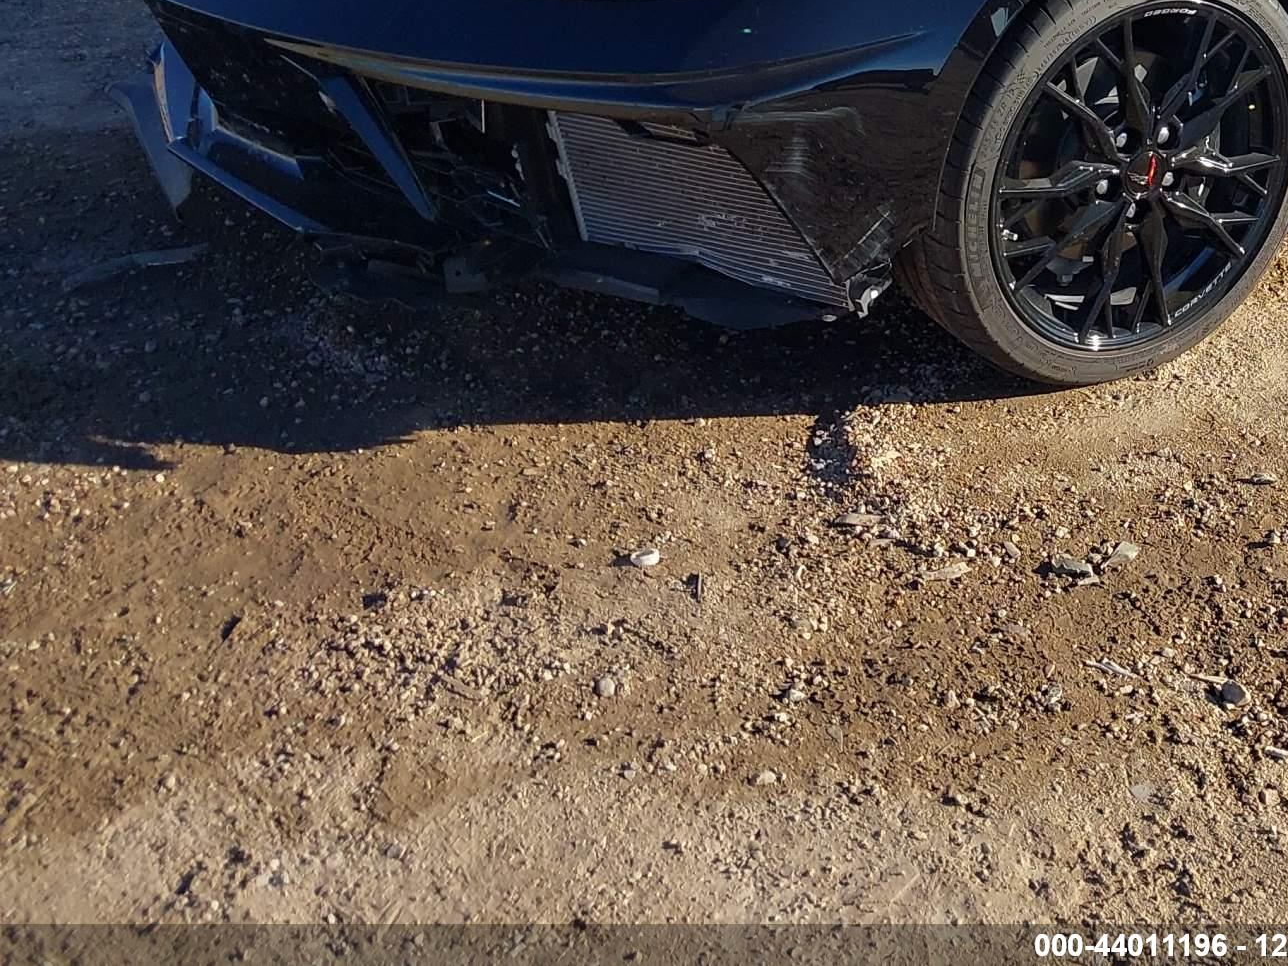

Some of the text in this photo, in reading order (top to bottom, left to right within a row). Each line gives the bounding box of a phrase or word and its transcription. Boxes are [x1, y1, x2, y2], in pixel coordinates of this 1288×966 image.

[1143, 8, 1198, 18] FORGED
[966, 173, 985, 279] MICHELIN
[1174, 261, 1231, 318] CORVETTE
